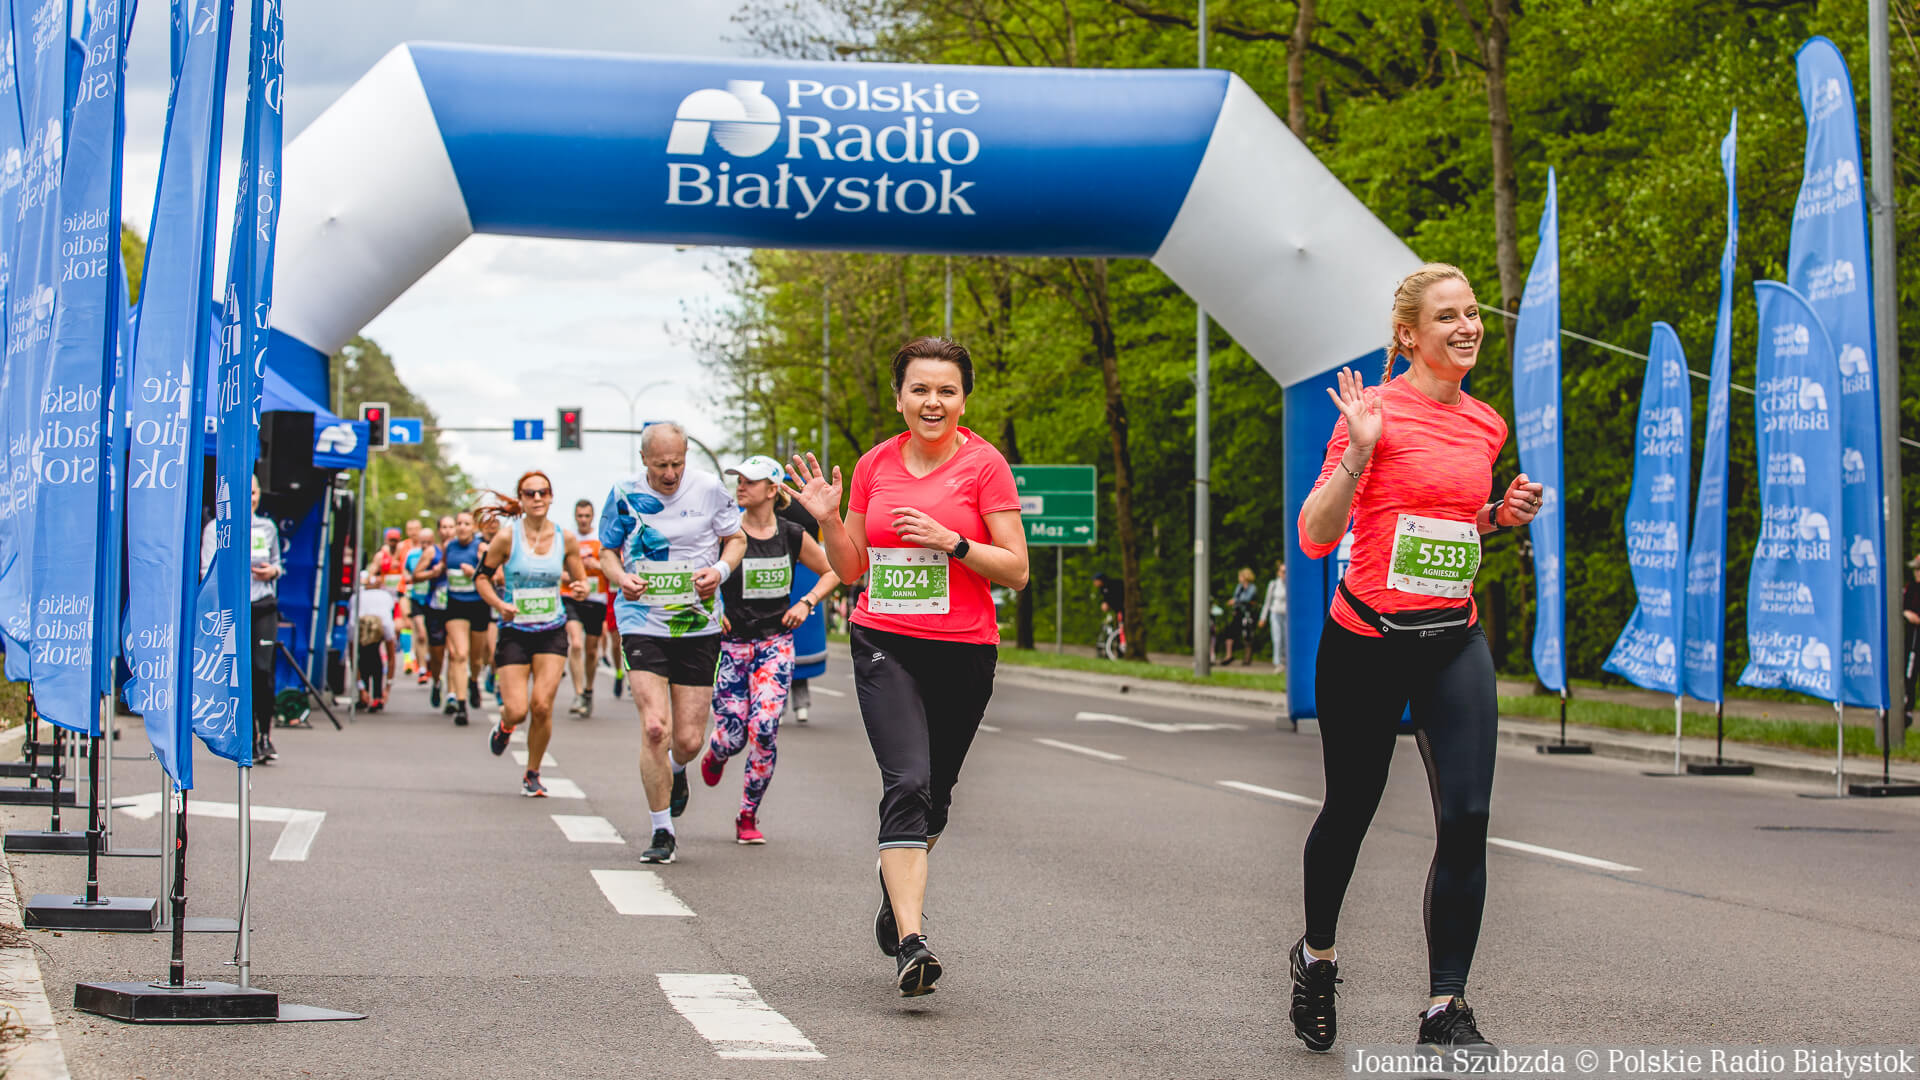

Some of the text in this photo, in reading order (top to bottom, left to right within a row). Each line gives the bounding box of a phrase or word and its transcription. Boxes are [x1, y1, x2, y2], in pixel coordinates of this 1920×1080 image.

[786, 79, 981, 115] Polskie
[785, 114, 980, 165] Radio
[665, 161, 976, 220] Białystok
[1416, 543, 1467, 569] 5533
[648, 575, 682, 589] 5076
[755, 570, 785, 583] 5359
[883, 569, 930, 589] 5024
[1422, 567, 1460, 578] AGNIESZKA
[892, 590, 918, 598] JOANNA
